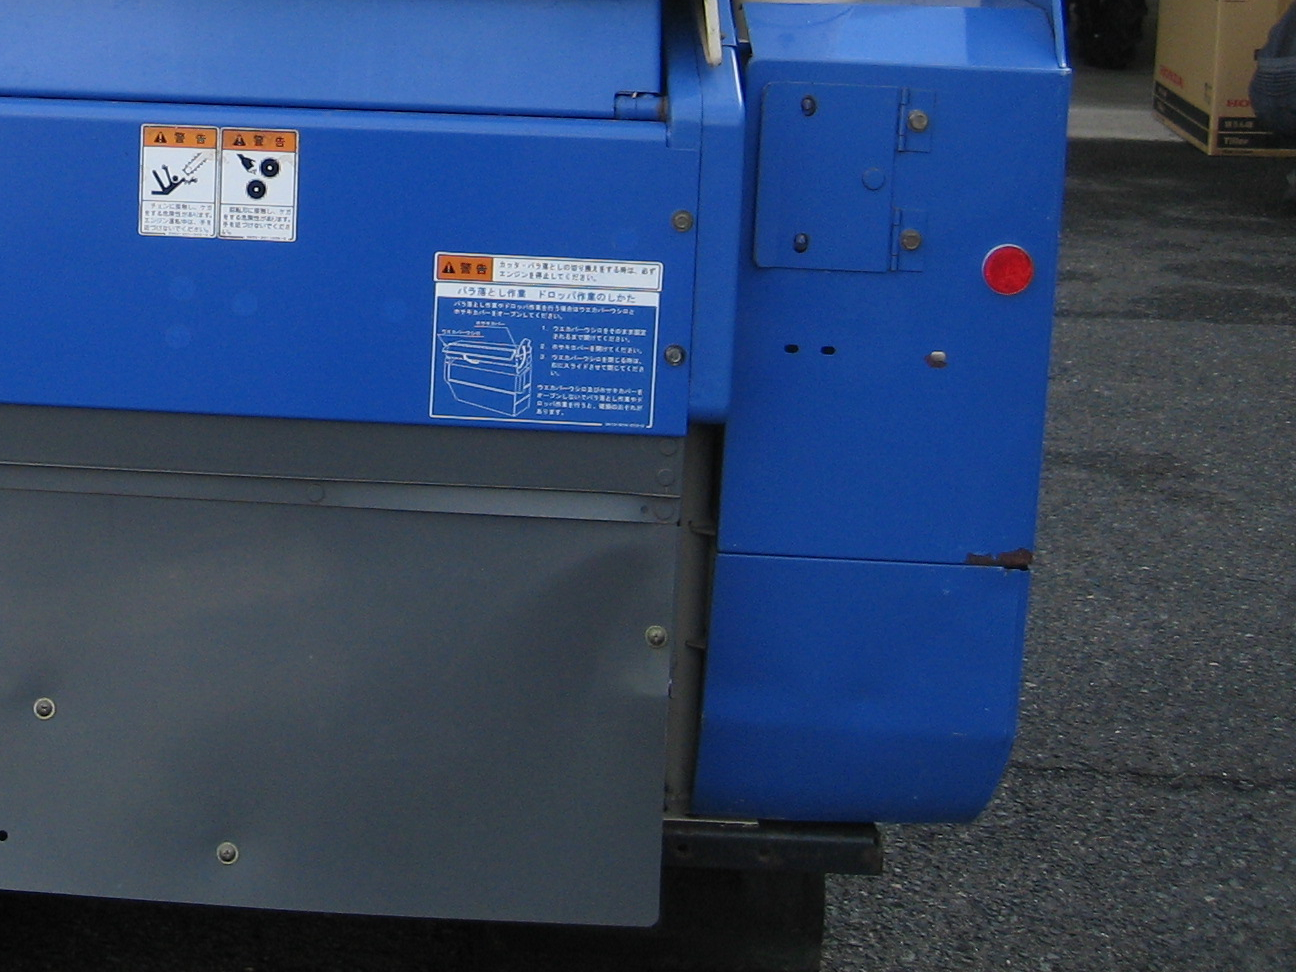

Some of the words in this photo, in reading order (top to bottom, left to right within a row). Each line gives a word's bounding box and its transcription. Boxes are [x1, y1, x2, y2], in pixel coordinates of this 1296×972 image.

[174, 131, 206, 145] 警告
[253, 134, 286, 148] 警告
[460, 262, 487, 275] 警告
[457, 287, 527, 298] バラ落とし作業
